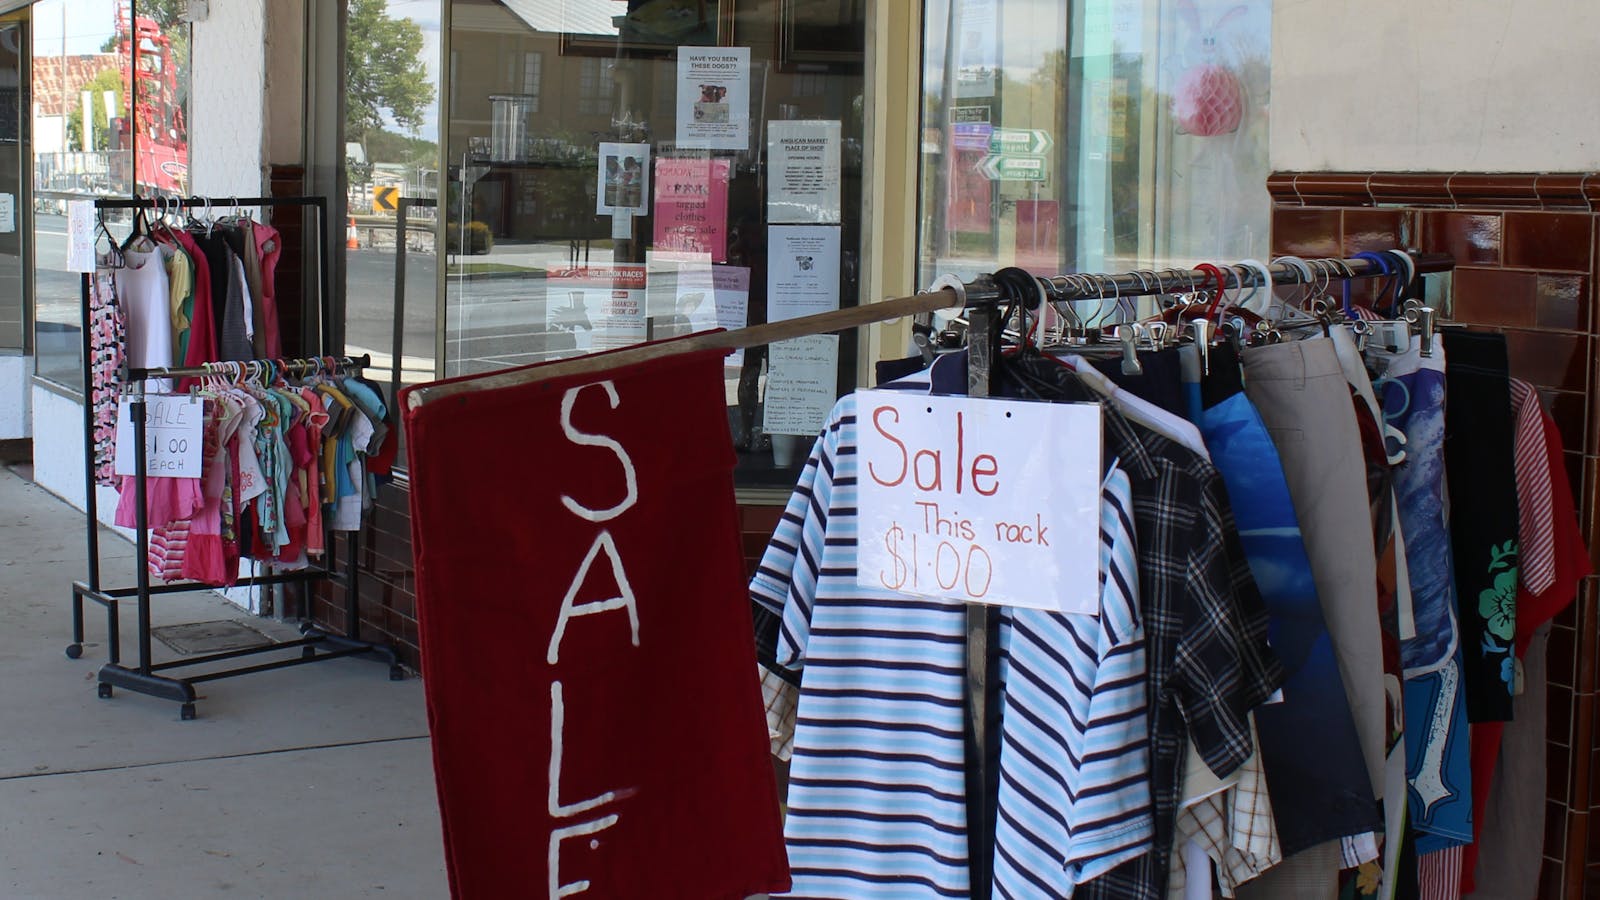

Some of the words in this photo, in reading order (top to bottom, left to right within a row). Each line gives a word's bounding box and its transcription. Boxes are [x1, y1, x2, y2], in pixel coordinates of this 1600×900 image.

[675, 211, 706, 221] clothes
[700, 226, 717, 234] sale
[622, 270, 644, 278] RACES
[868, 405, 999, 497] Sale
[149, 458, 184, 470] EACH
[914, 501, 976, 541] This
[995, 513, 1049, 547] rack
[880, 520, 993, 598] $1.00
